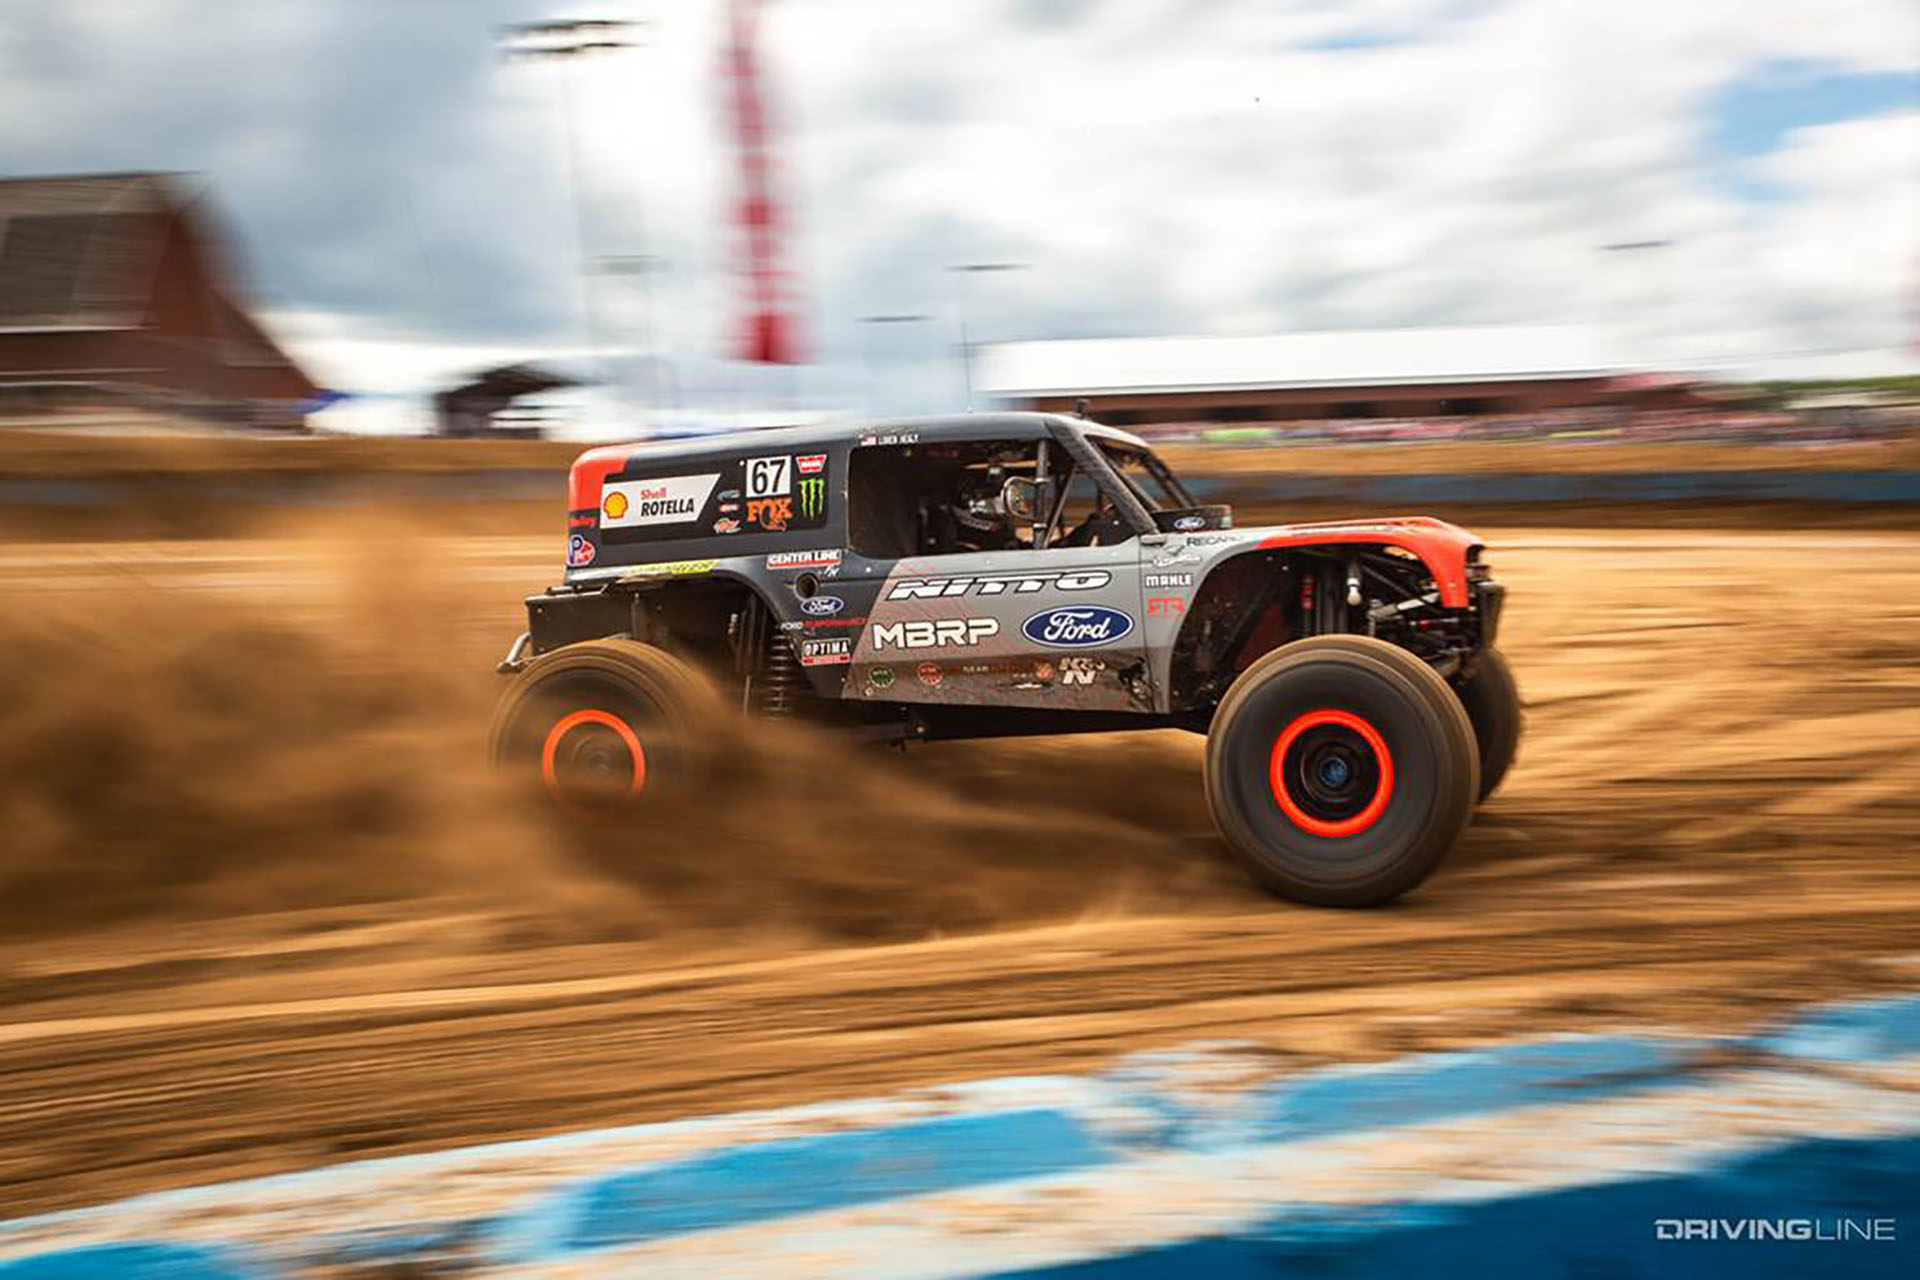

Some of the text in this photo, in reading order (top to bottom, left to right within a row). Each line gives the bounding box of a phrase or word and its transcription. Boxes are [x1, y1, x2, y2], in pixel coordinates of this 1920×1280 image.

[752, 459, 785, 494] 67
[640, 487, 667, 500] Shell
[641, 498, 694, 517] ROTELLA
[746, 498, 793, 531] FOX
[814, 549, 842, 561] LINE
[887, 570, 1112, 601] NITTO
[1145, 574, 1192, 587] MAHLE
[872, 618, 999, 650] MBRP
[1042, 611, 1112, 640] Ford
[804, 641, 848, 656] OPTIMA
